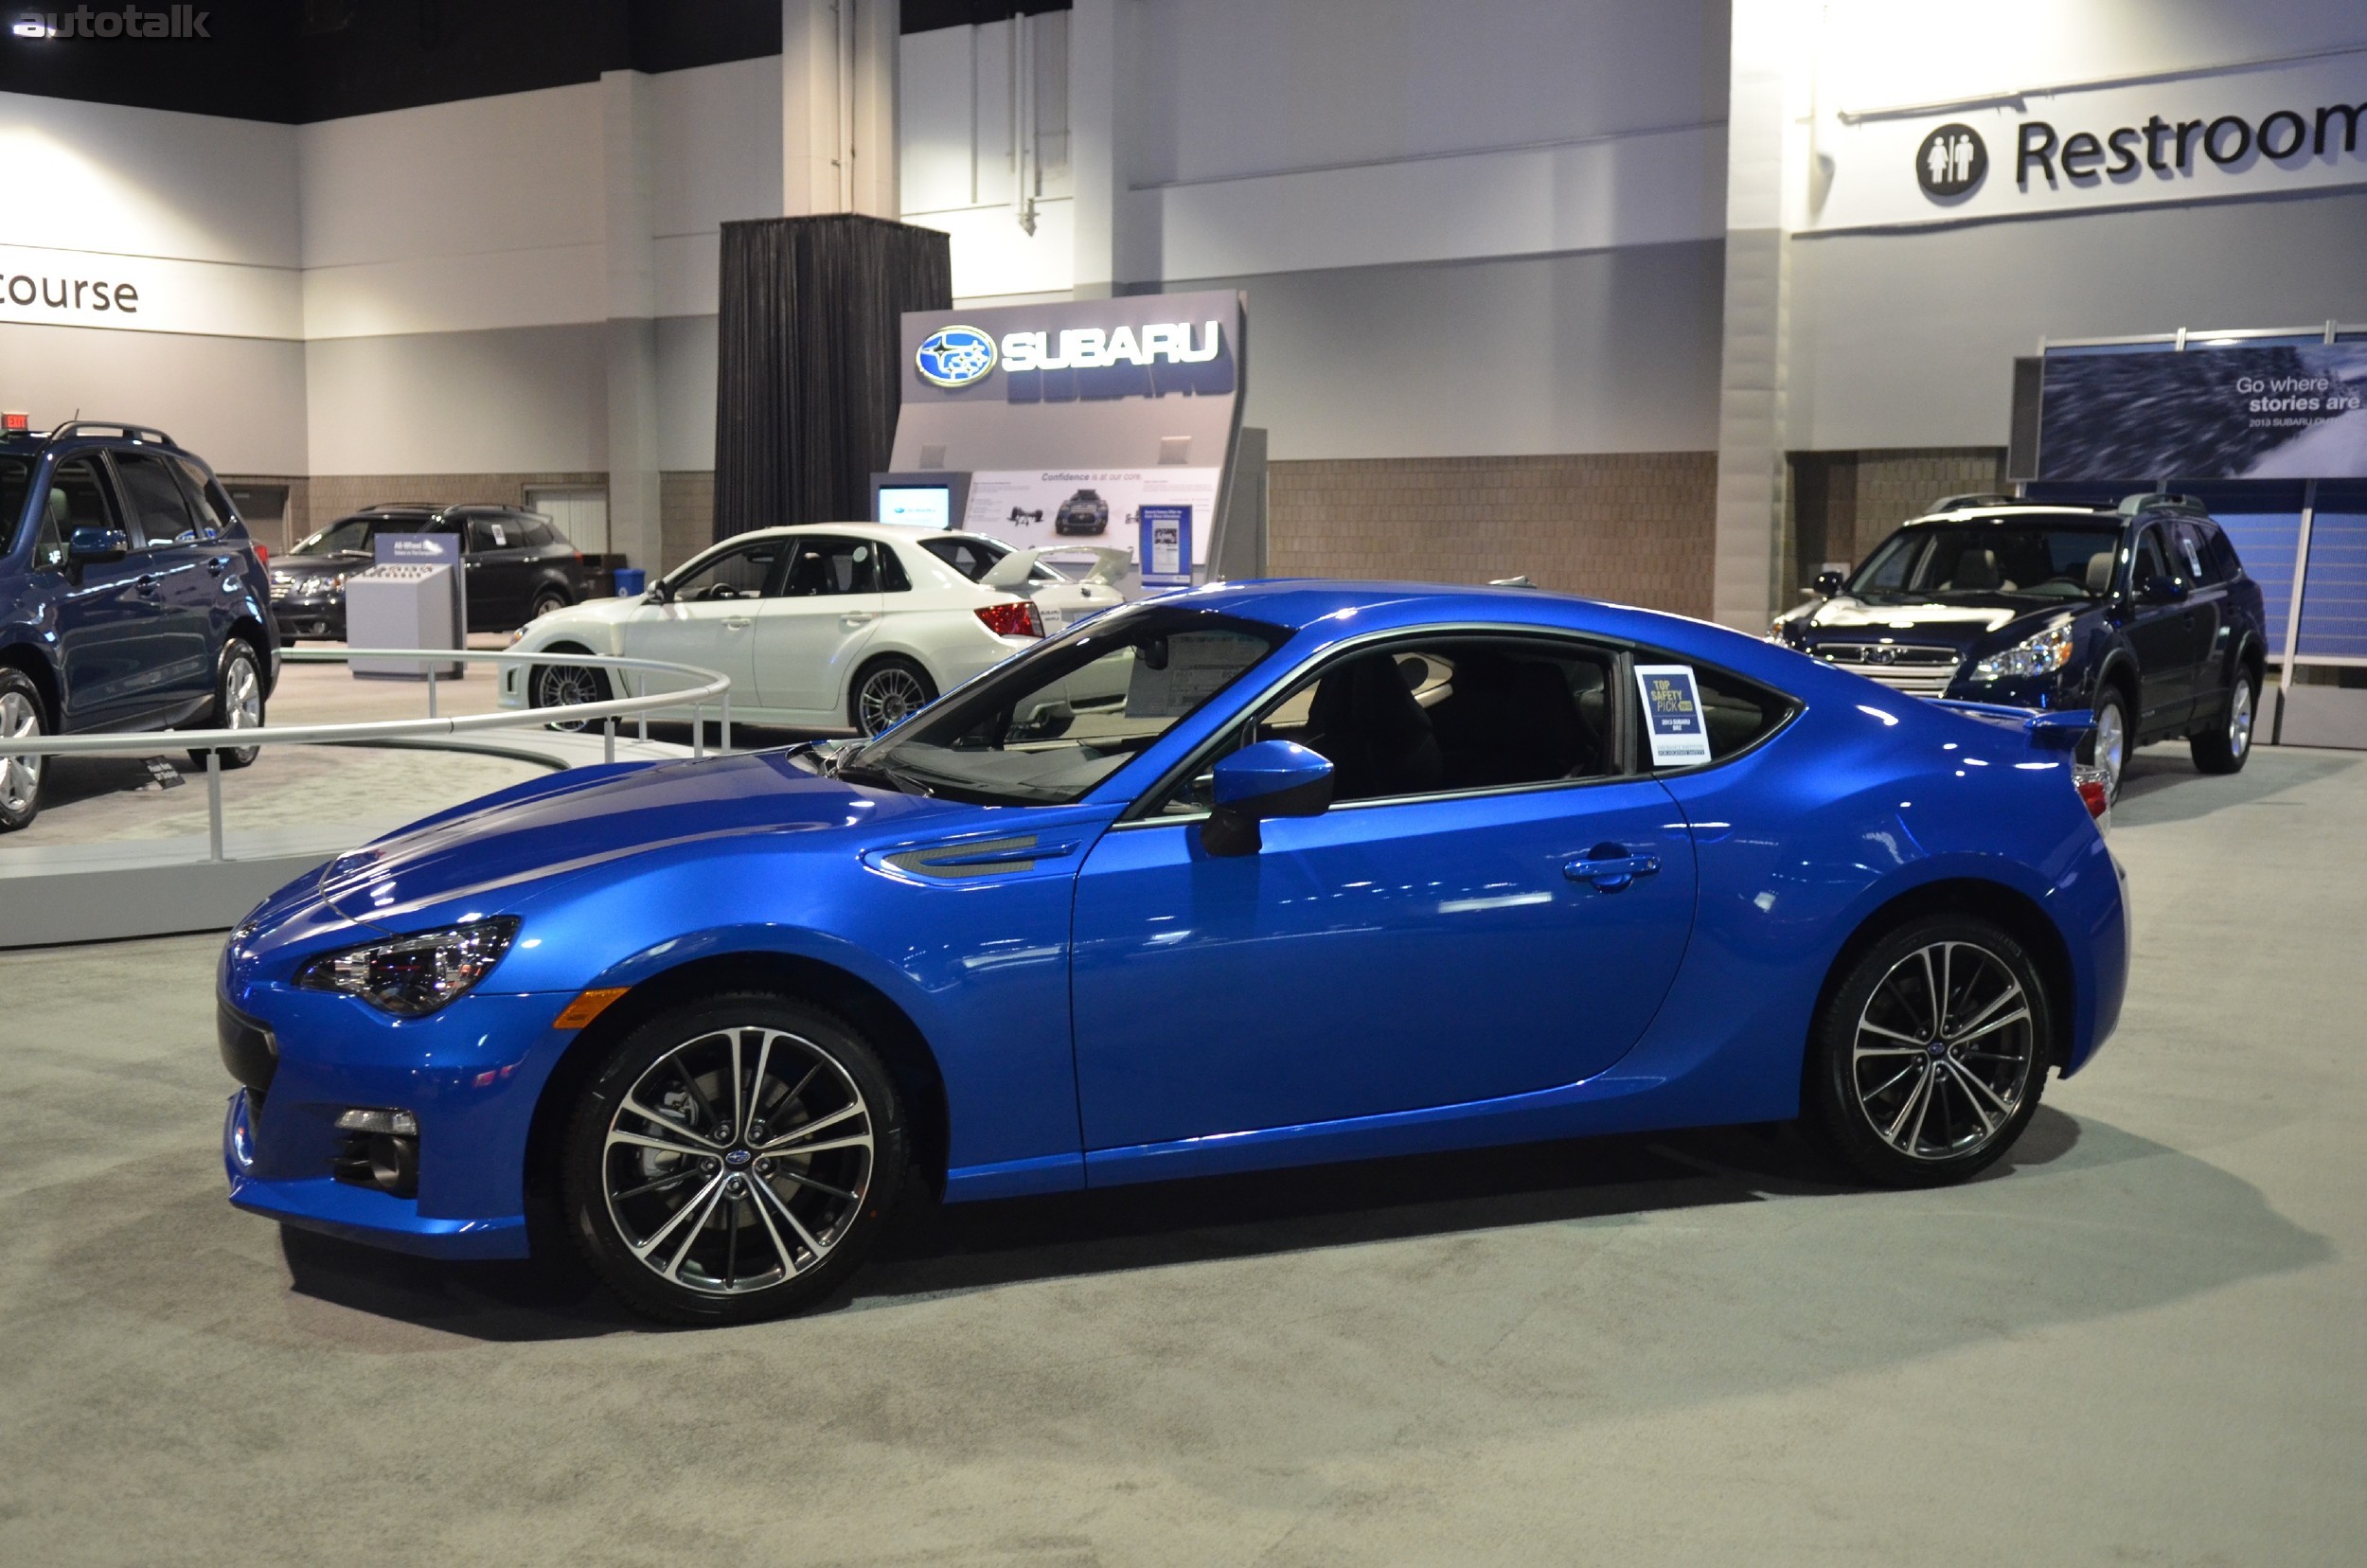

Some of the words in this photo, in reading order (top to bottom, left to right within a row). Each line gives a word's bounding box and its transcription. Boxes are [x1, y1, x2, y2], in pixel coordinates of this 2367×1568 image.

[0, 274, 138, 313] ourse
[1002, 320, 1219, 372] SUBARU
[2236, 377, 2265, 394] Go
[2270, 375, 2329, 392] where
[2249, 395, 2321, 412] stories
[2325, 397, 2360, 410] are
[8, 416, 27, 428] EXIT
[2249, 419, 2271, 428] 2013
[2272, 417, 2312, 427] SUBARU
[1041, 472, 1090, 481] Confidence
[1653, 680, 1670, 689] TOP
[1650, 690, 1682, 701] SAFETY
[1657, 701, 1678, 712] PICK
